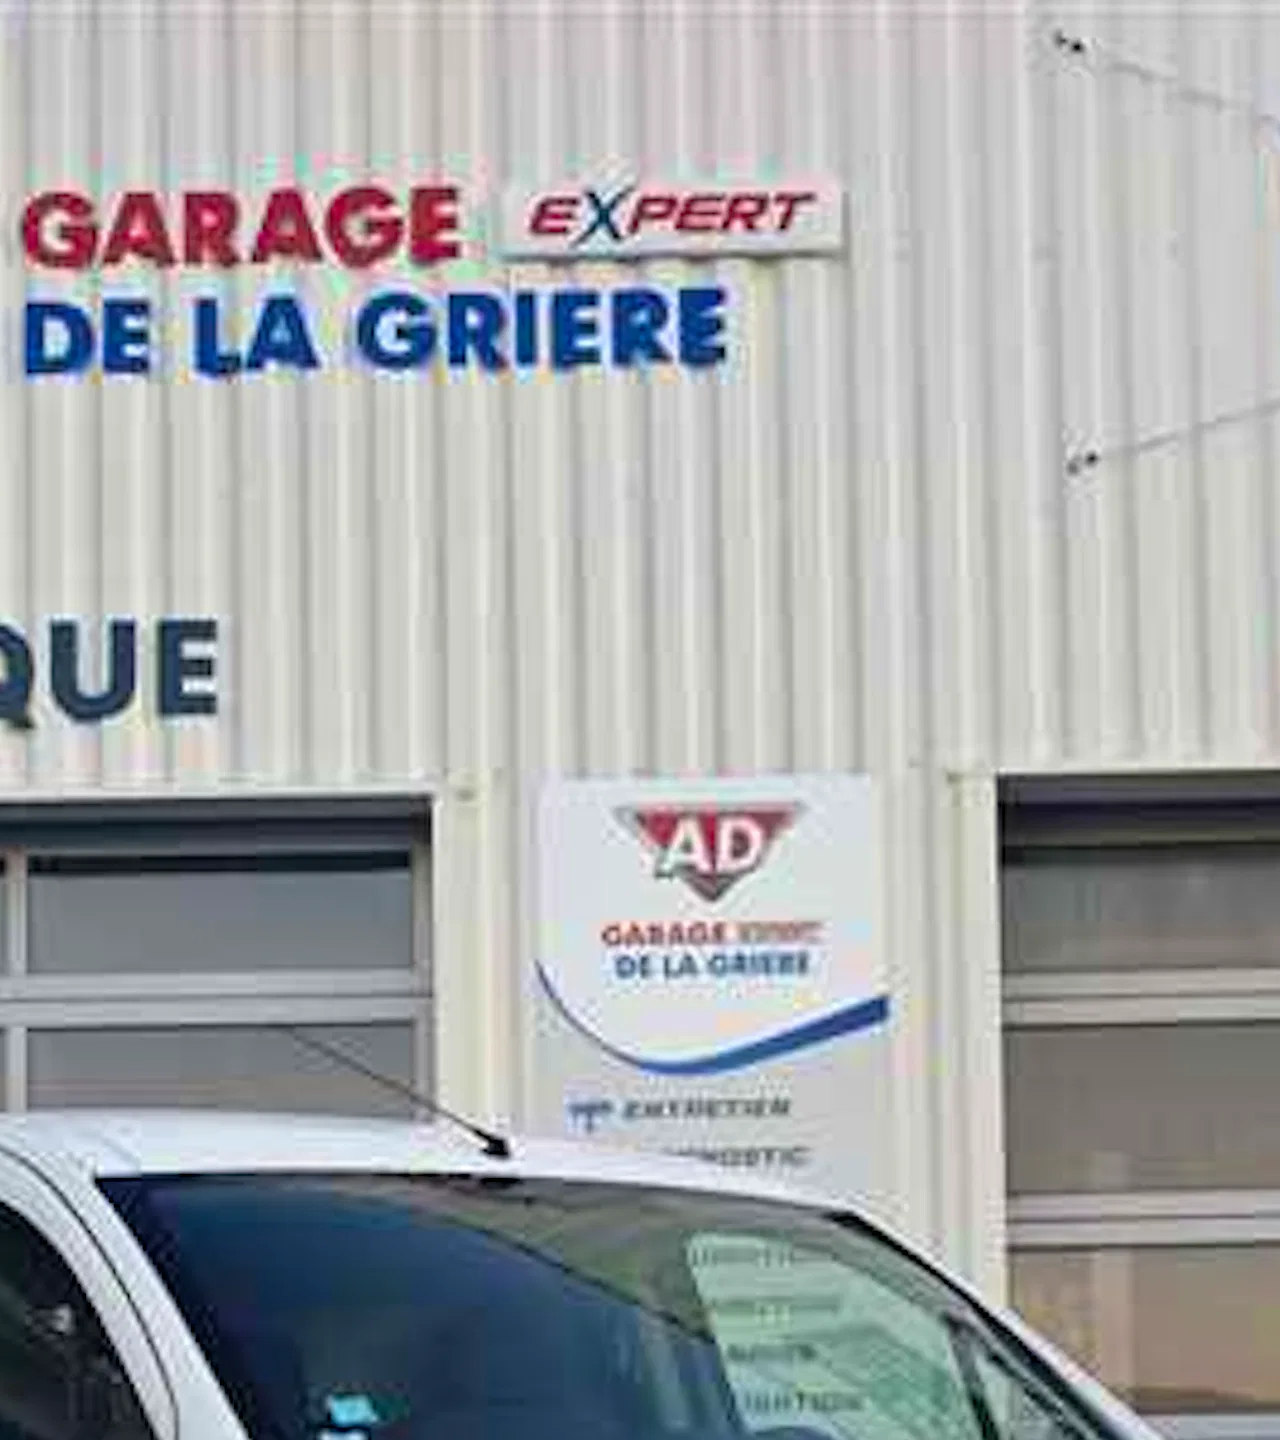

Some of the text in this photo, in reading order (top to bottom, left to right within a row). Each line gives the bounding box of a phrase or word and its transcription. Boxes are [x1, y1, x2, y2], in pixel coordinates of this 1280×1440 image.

[21, 186, 462, 269] GARAGE
[526, 188, 817, 245] EXPERT
[23, 286, 727, 376] DE LA GRIERE
[654, 814, 763, 877] AD
[601, 921, 726, 947] GARAGE
[614, 955, 651, 979] DE
[663, 954, 699, 977] LA
